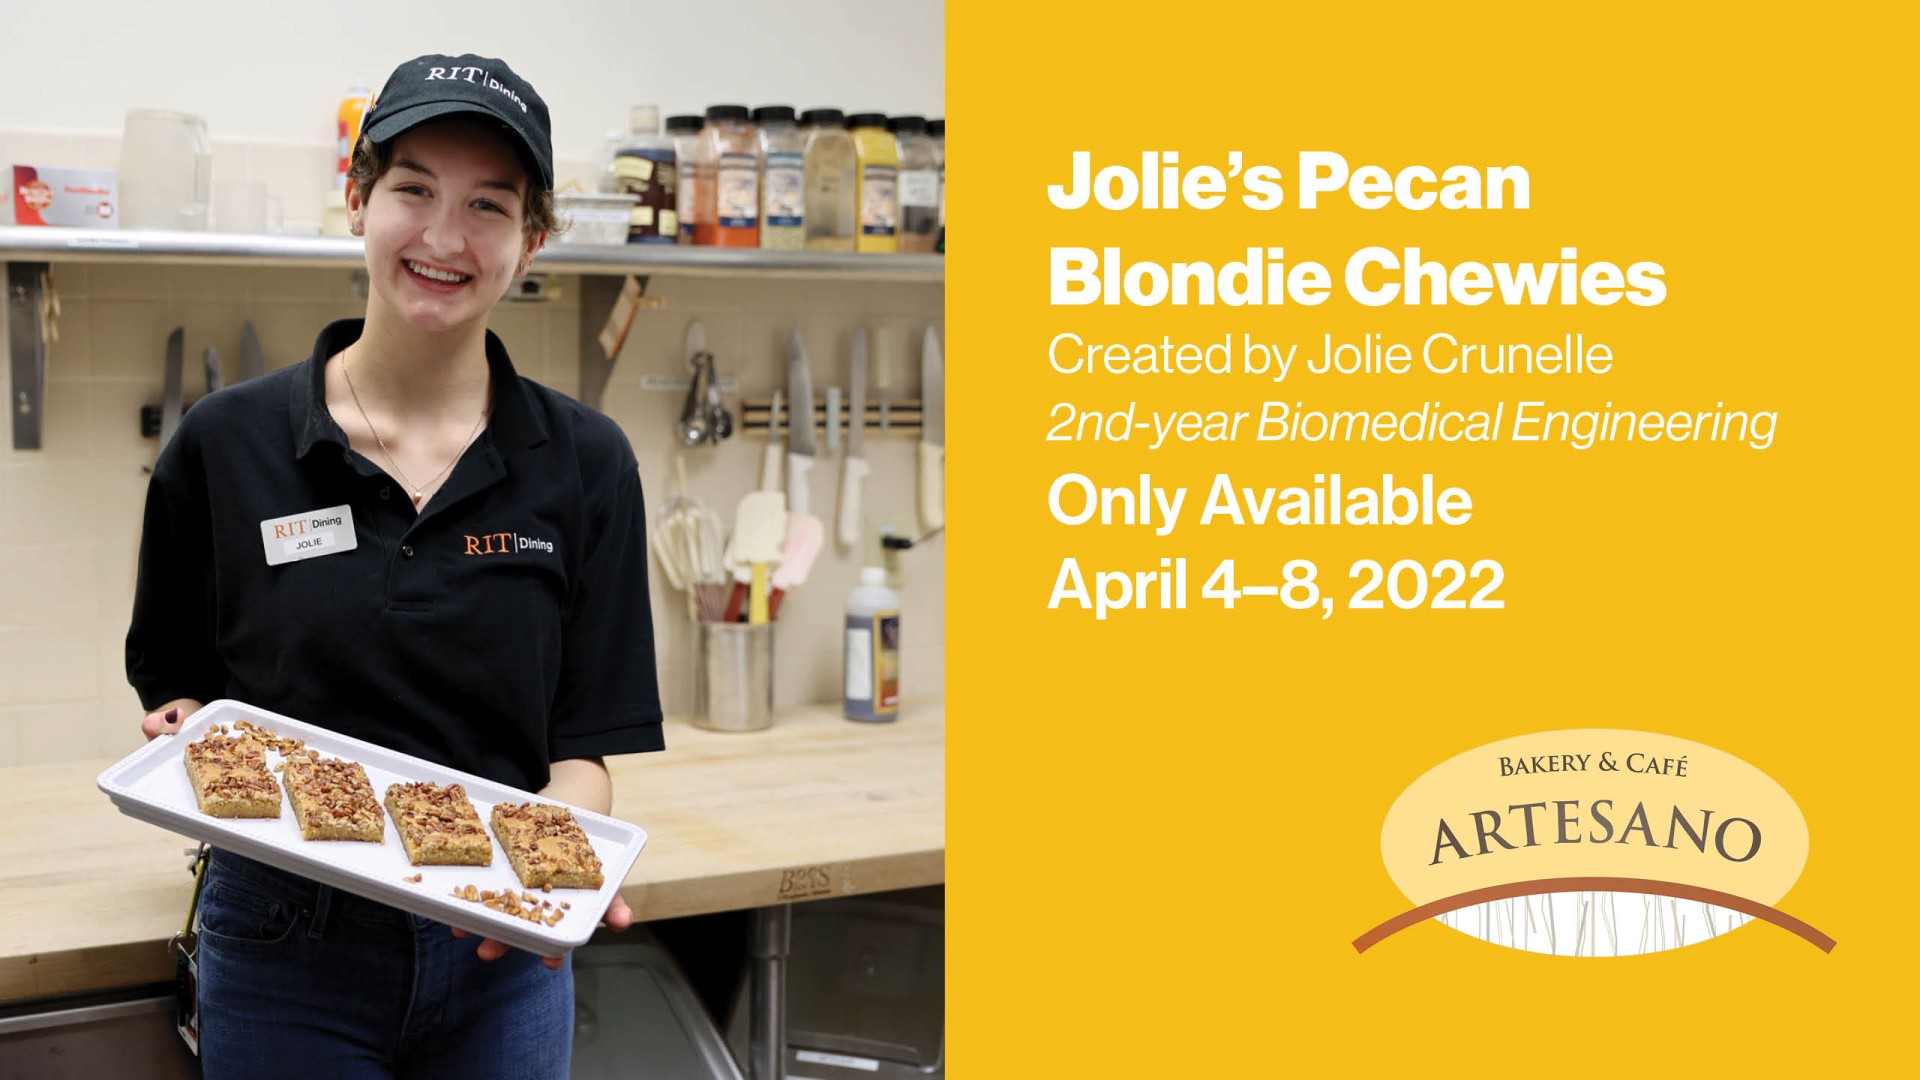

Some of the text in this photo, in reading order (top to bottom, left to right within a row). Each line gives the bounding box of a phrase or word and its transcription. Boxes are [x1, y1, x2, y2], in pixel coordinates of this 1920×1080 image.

[425, 66, 527, 114] RIT Dining
[273, 517, 342, 539] RIT Dining
[296, 537, 323, 550] JOLIE
[463, 533, 554, 555] RIT Dining
